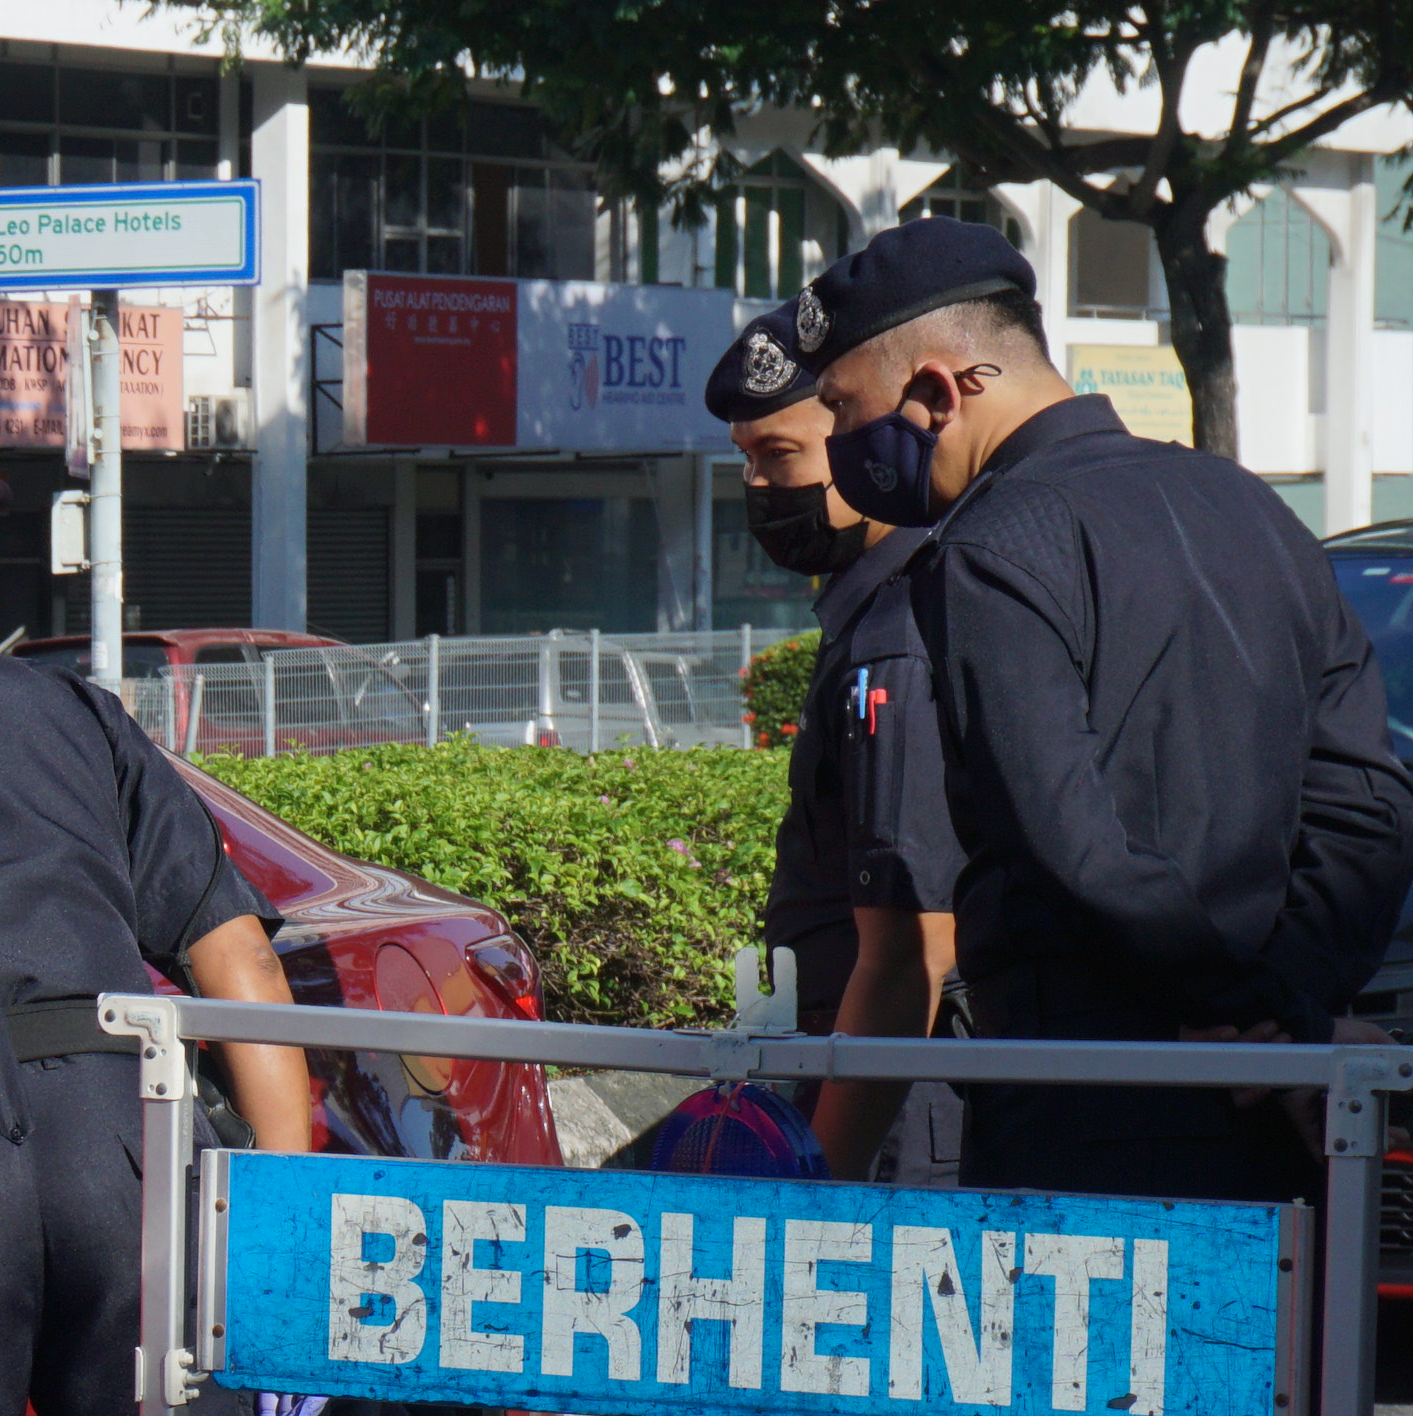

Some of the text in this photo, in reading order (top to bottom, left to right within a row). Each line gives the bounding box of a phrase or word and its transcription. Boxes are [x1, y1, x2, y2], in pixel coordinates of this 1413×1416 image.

[38, 213, 106, 235] Palace
[114, 211, 181, 232] Hotels
[374, 289, 511, 313] PUSAT ALAT PENDENGARAN
[569, 327, 600, 345] BEST
[603, 334, 686, 388] BEST
[328, 1193, 1170, 1416] BERHENTI
